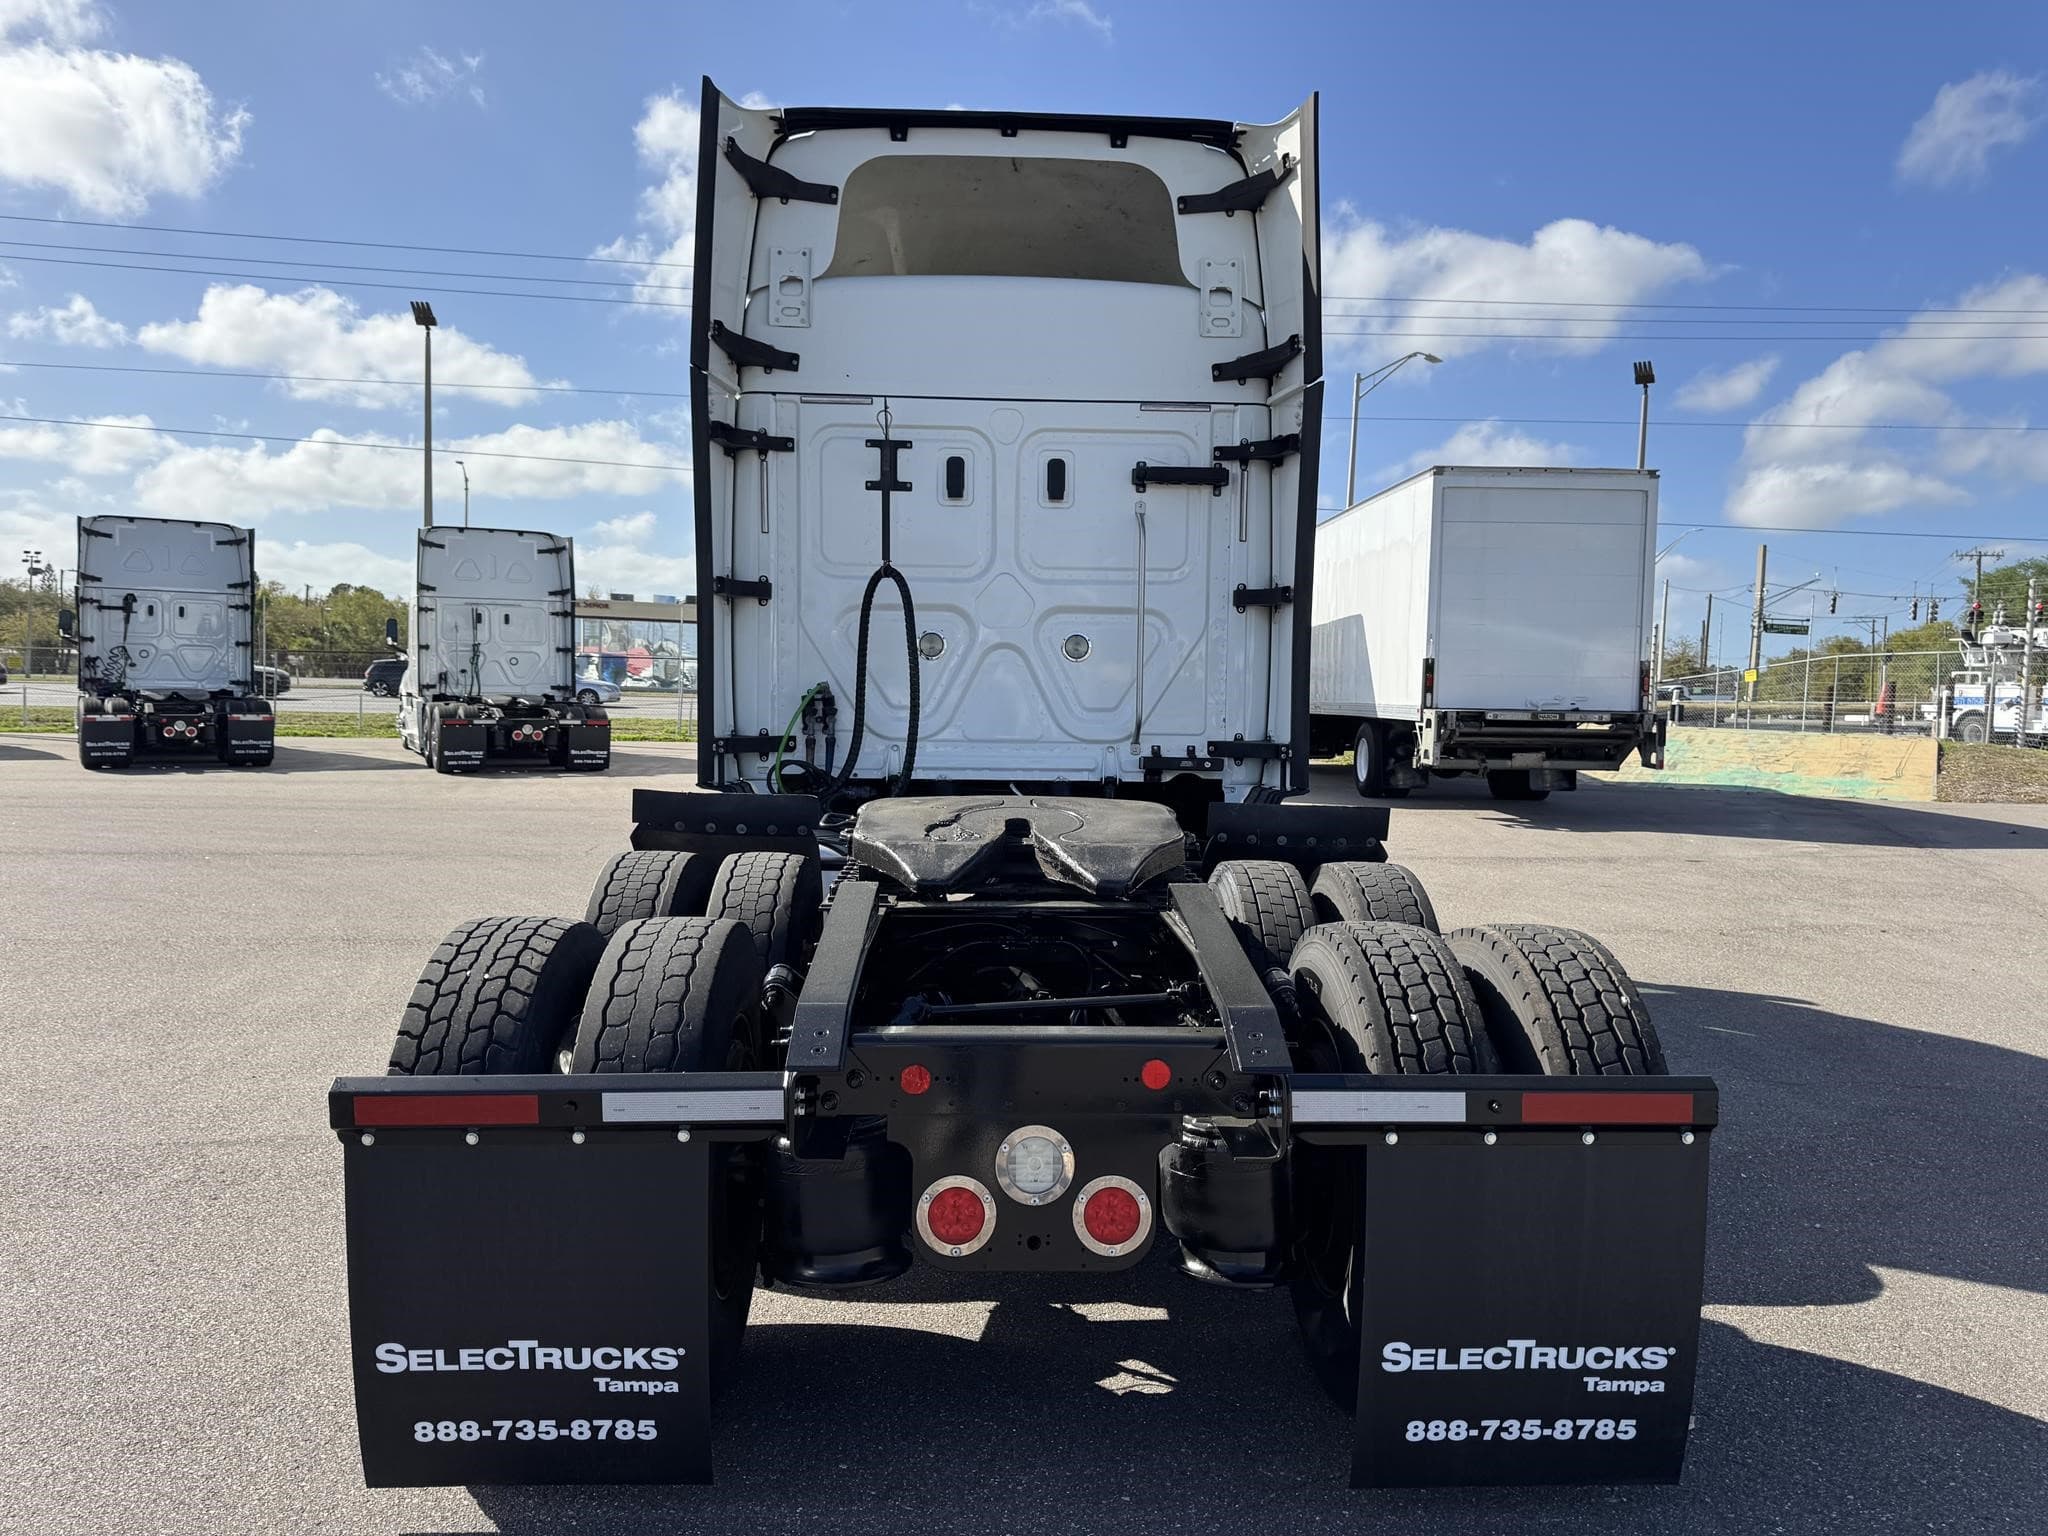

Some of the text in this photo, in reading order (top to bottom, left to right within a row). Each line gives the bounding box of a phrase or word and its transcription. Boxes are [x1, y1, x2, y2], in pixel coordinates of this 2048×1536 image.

[592, 1377, 679, 1396] Tampa
[1582, 1376, 1665, 1396] Tampa
[413, 1419, 658, 1443] 888-735-8785
[1405, 1418, 1637, 1442] 888-735-8785
